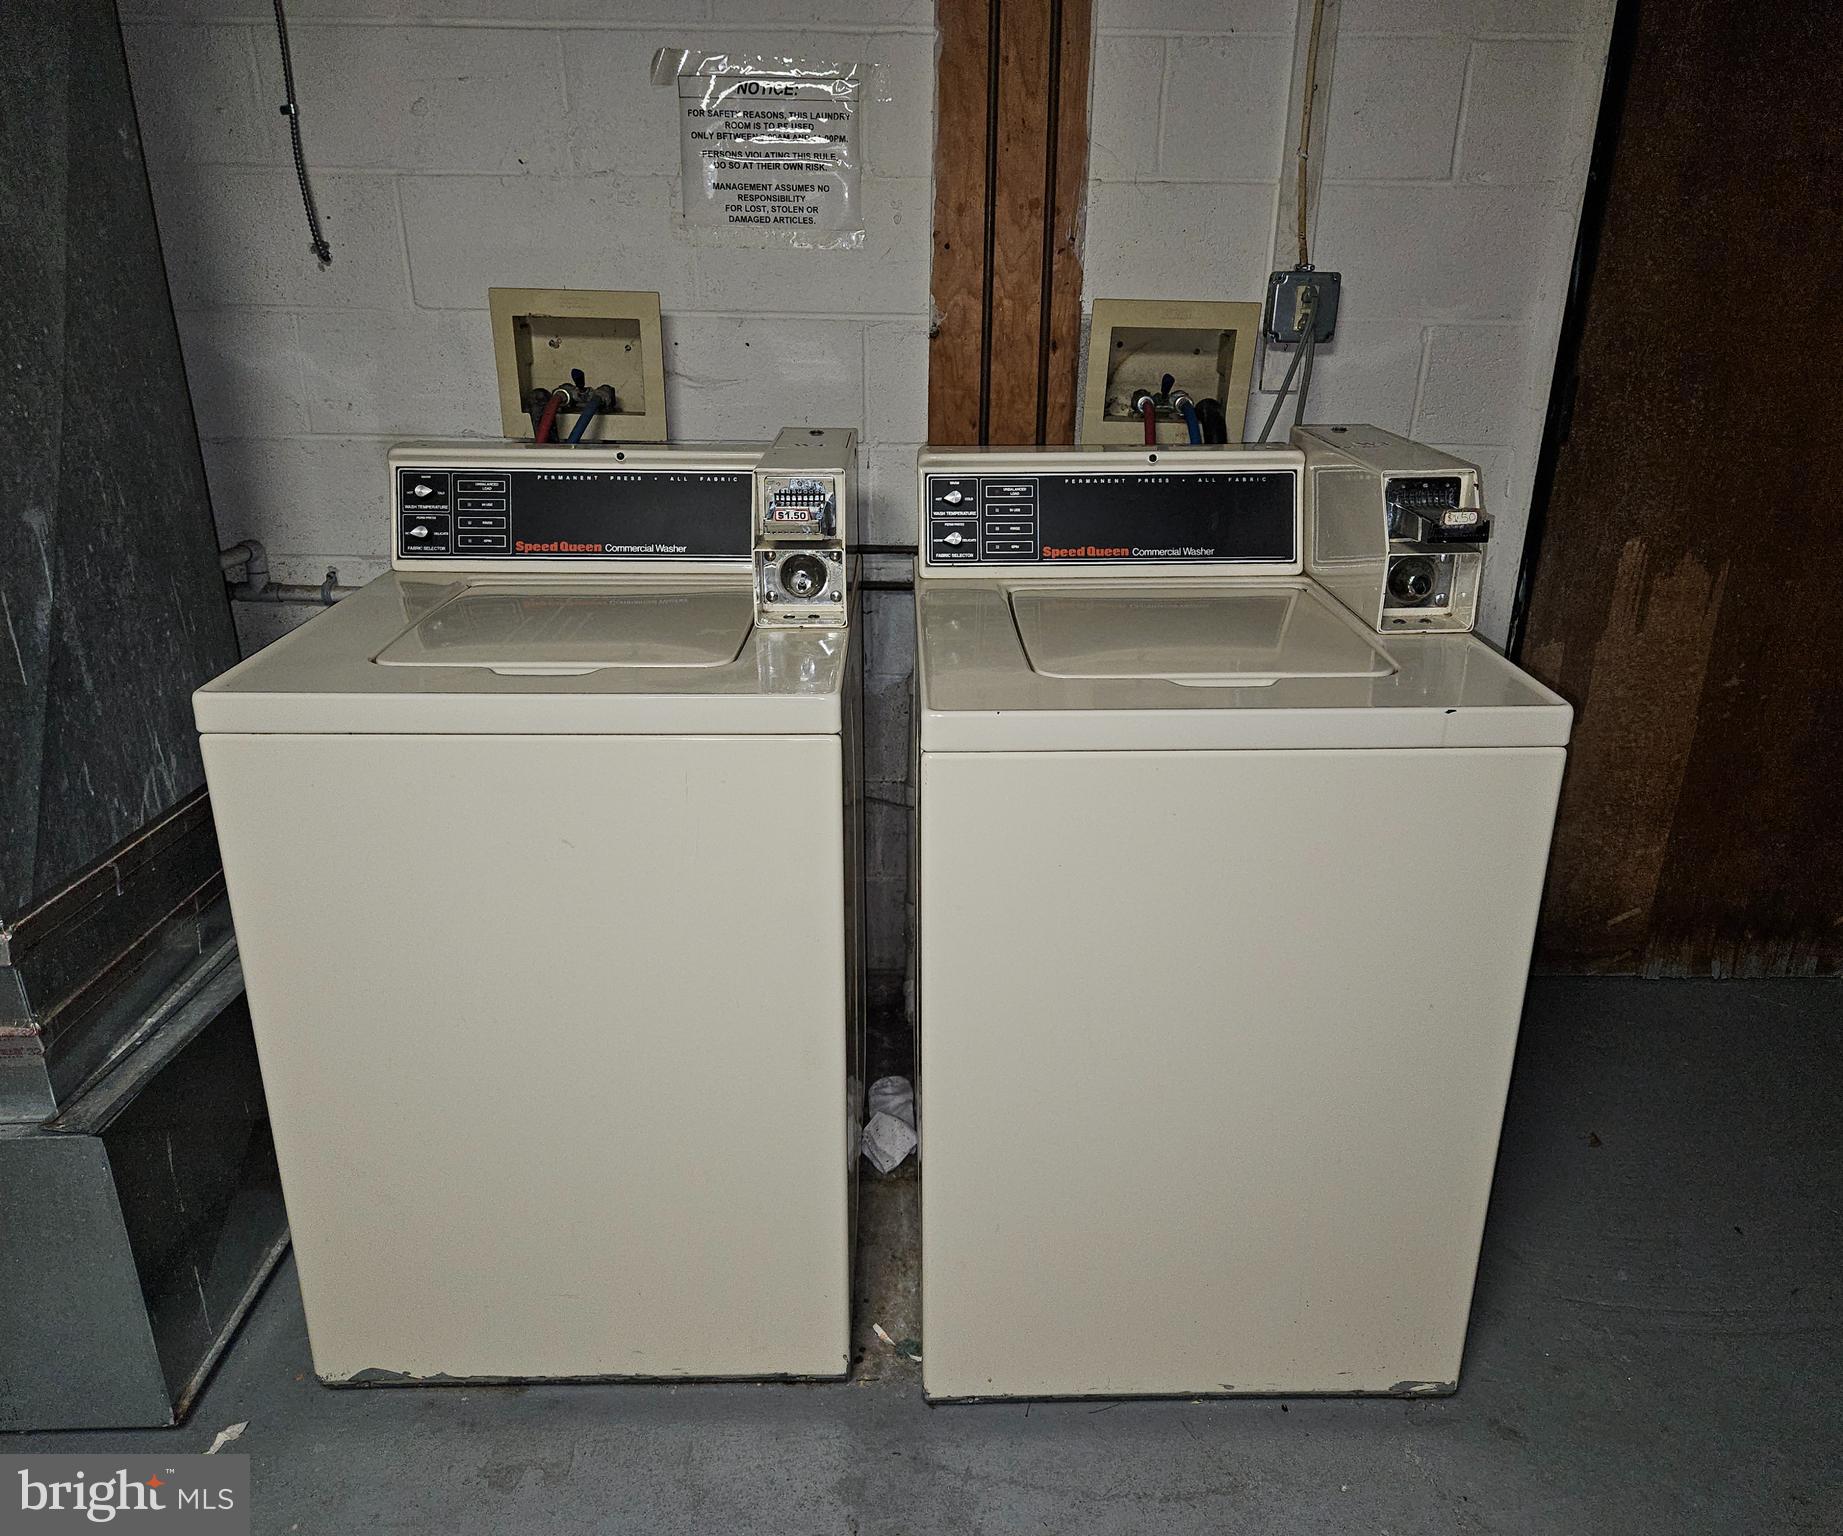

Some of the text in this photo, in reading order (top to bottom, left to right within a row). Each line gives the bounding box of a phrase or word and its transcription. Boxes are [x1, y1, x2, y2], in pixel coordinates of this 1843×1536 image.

[737, 81, 799, 97] NOTICE:
[687, 109, 850, 121] FOR SAFETY REASONS, THIS LAUNDRY
[724, 122, 815, 131] ROOM IS TO BE USED
[691, 132, 715, 140] ONLY
[702, 151, 743, 159] PERSONS
[745, 151, 790, 160] VIOLATING
[793, 152, 811, 160] THIS
[714, 162, 828, 172] DO SO AT THEIR OWN RISK.
[712, 182, 772, 191] MANAGEMENT
[774, 184, 816, 192] ASSUMES
[737, 194, 806, 203] RESPONSIBILITY
[725, 205, 819, 214] FOR LOST, STOLEN OR
[728, 215, 816, 225] DAMAGED ARTICLES.
[777, 511, 806, 520] $1.50
[515, 541, 687, 553] Speed Queen Commercial Washer
[1043, 546, 1215, 559] Speed Queen Commercial Washer
